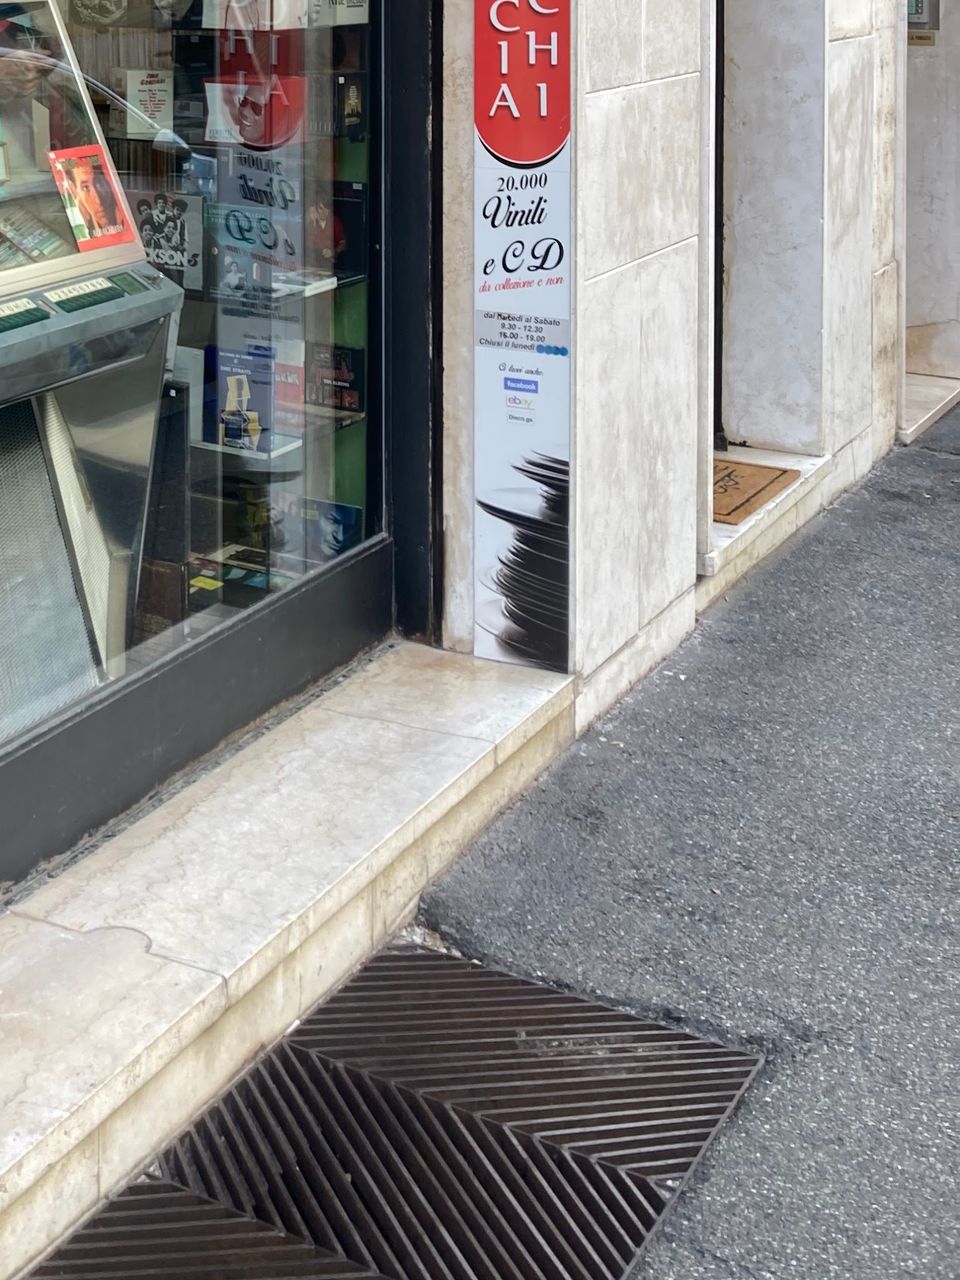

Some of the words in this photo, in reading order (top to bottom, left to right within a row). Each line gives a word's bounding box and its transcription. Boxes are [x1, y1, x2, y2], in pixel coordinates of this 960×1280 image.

[497, 172, 547, 192] 20.000
[482, 195, 548, 229] Vinili
[483, 258, 496, 276] e
[483, 311, 496, 320] dal
[533, 316, 561, 327] Sabato
[523, 325, 544, 334] 12.30
[507, 380, 537, 391] facebook
